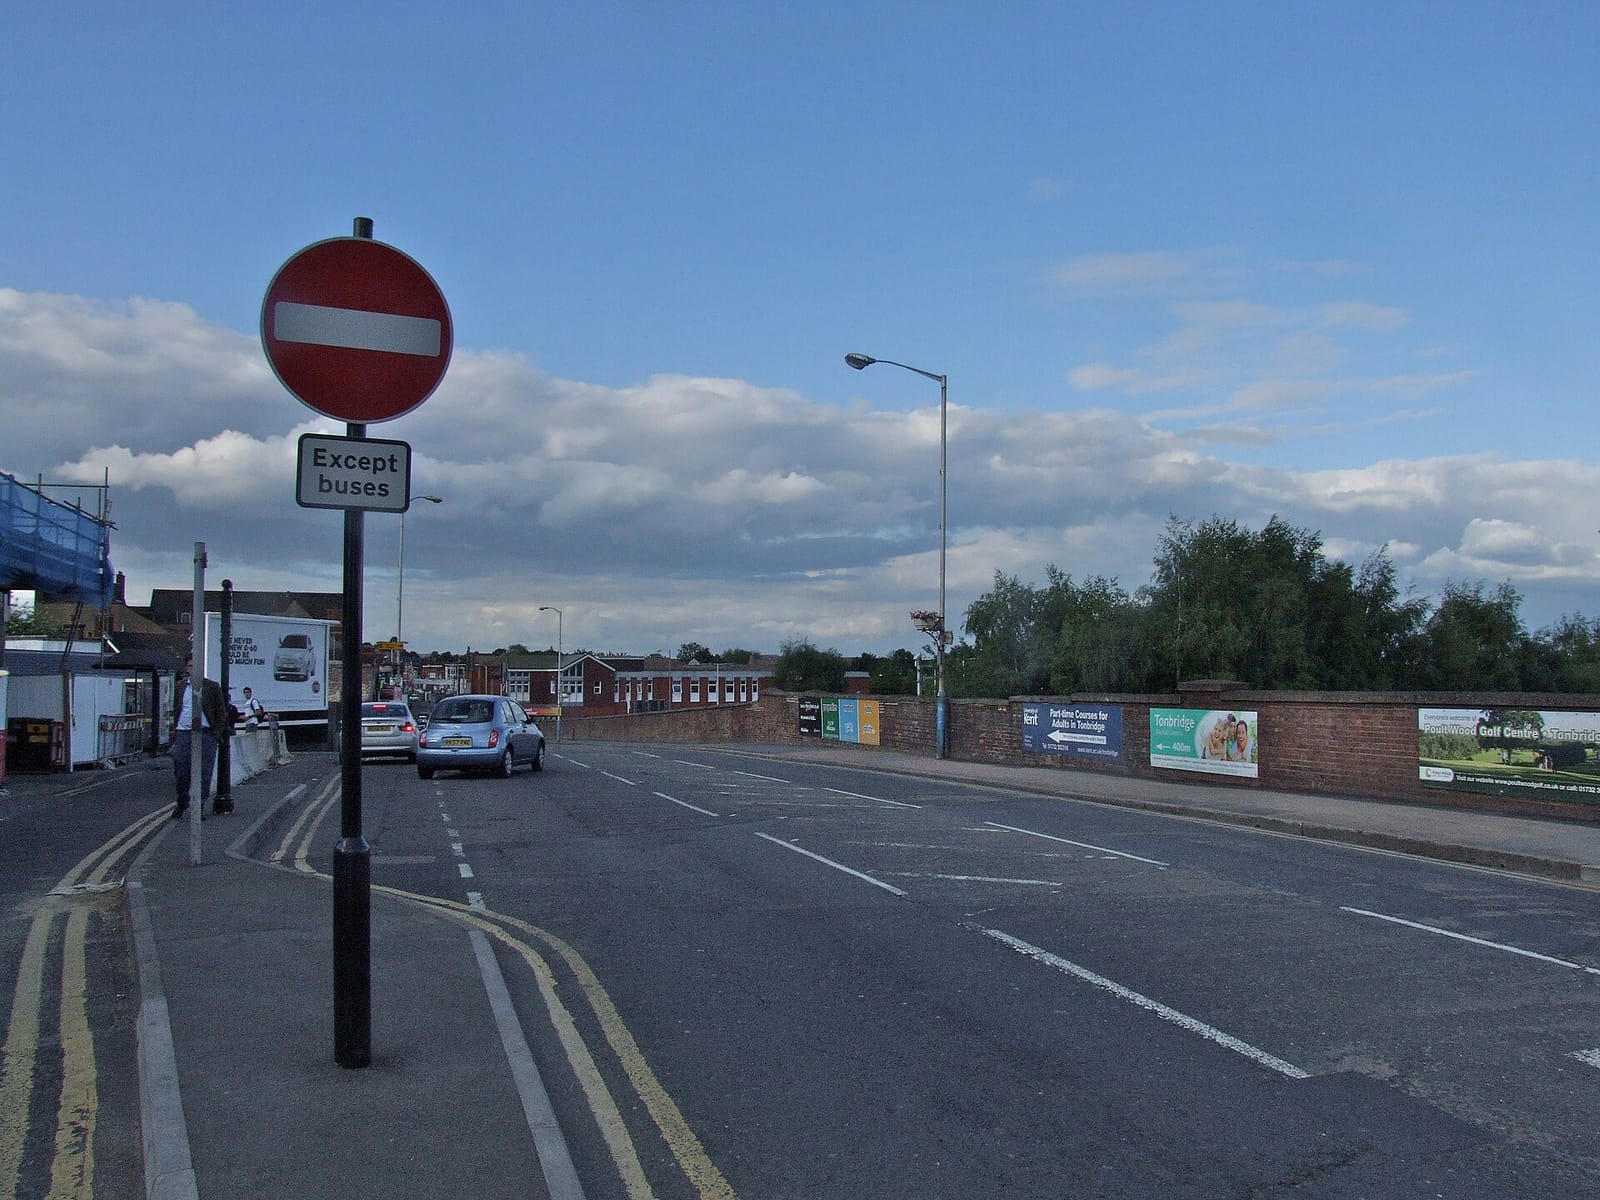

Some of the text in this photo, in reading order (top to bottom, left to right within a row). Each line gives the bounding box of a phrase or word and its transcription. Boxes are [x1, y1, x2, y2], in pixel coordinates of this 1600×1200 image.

[313, 448, 398, 474] Except
[319, 474, 389, 497] buses
[234, 637, 253, 645] NEVER
[253, 658, 266, 666] FUN
[1023, 713, 1038, 726] Kent
[1049, 708, 1108, 720] Part-time Courses for
[1051, 719, 1105, 733] Adults in Tonbridge
[1154, 714, 1195, 732] Tonbridge
[1424, 724, 1447, 734] Poult
[1450, 724, 1477, 736] Wood
[1479, 725, 1501, 737] Golf
[1503, 727, 1539, 738] Centre
[1172, 742, 1191, 753] 400m
